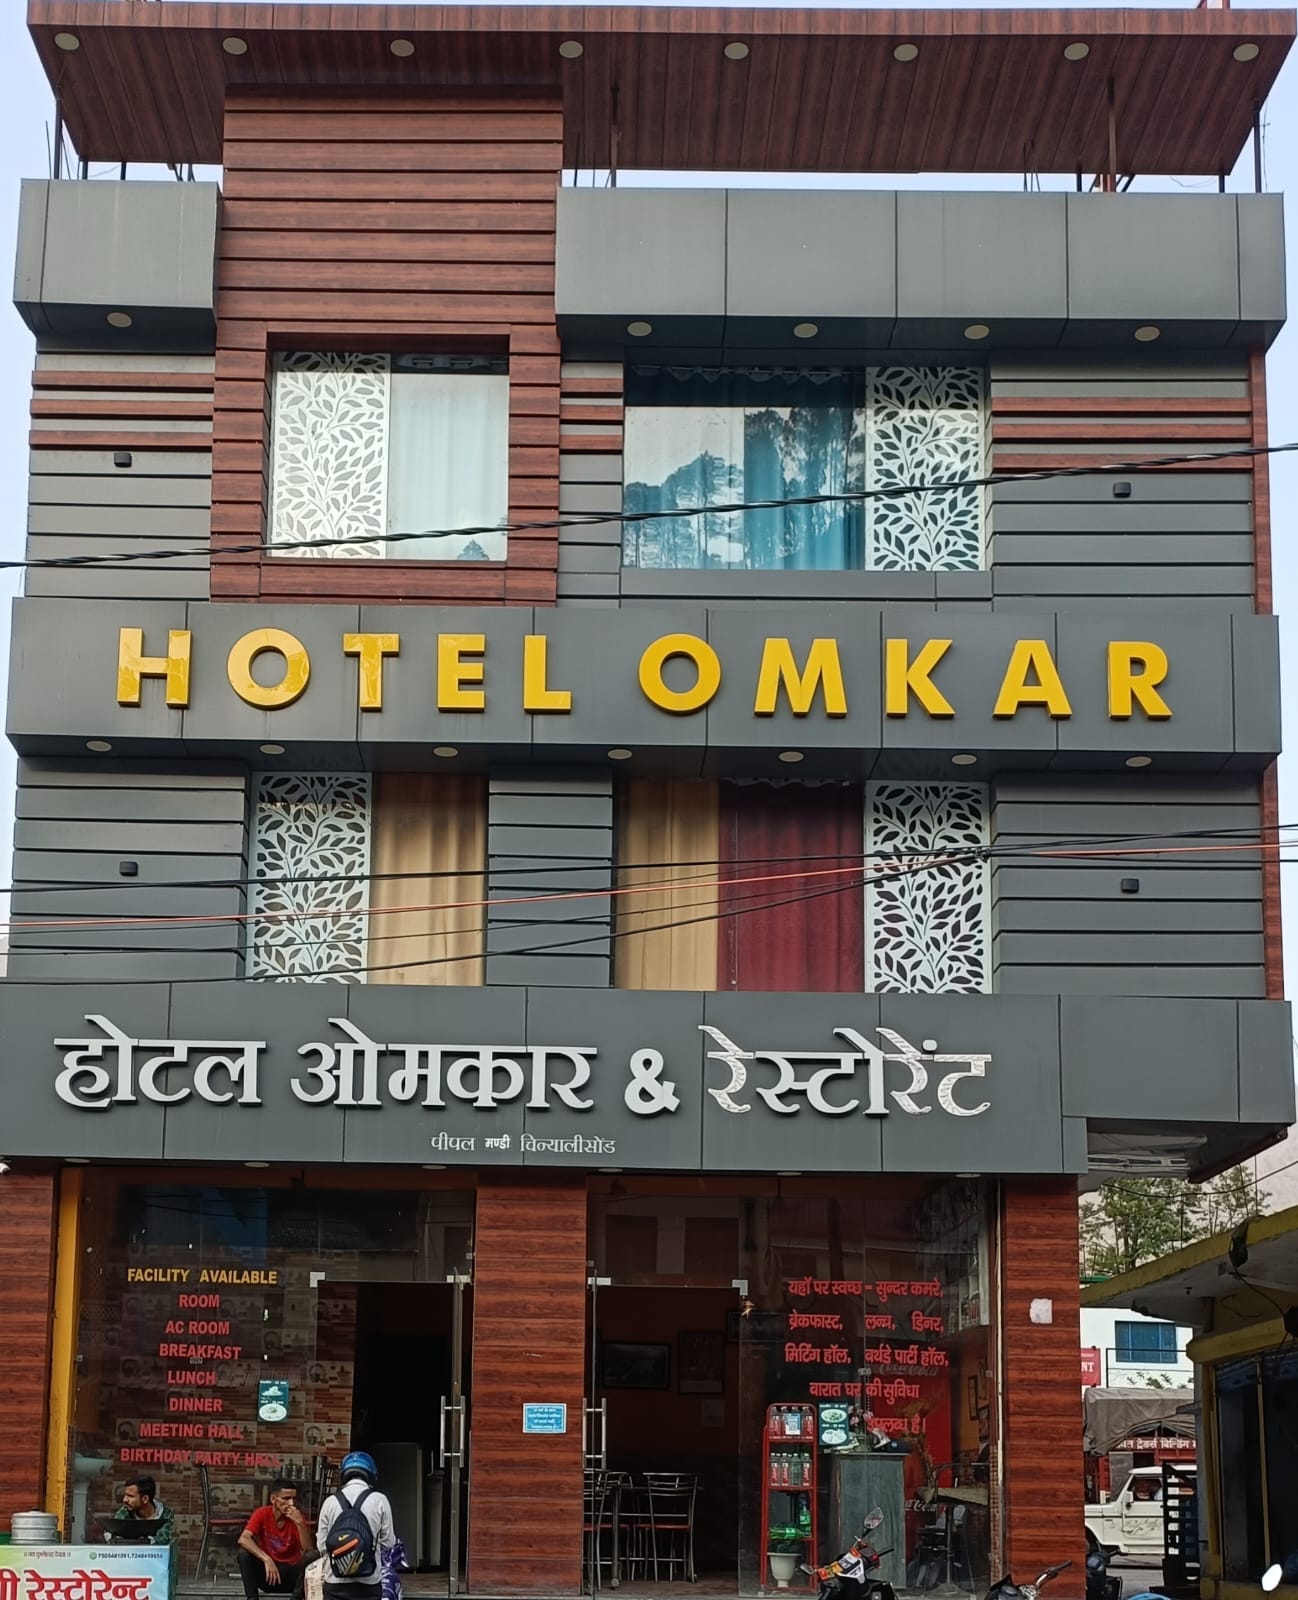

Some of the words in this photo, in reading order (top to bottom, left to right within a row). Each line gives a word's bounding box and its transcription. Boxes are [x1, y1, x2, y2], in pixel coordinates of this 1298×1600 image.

[116, 627, 572, 714] HOTEL
[638, 632, 1174, 721] OMKAR
[53, 1014, 267, 1110] होटल
[290, 1017, 598, 1111] ओमकार
[623, 1047, 681, 1115] &
[697, 1025, 992, 1117] रेस्टोरेंट
[430, 1131, 475, 1151] पीपल
[484, 1134, 511, 1149] मण्डी
[127, 1268, 190, 1282] FACILITY
[200, 1269, 278, 1284] AVAILABLE
[179, 1294, 220, 1308] ROOM
[813, 1280, 829, 1295] पर
[831, 1280, 863, 1295] स्वच्छ
[875, 1280, 909, 1303] सुन्दर
[165, 1320, 185, 1334] AC
[188, 1320, 230, 1335] ROOM
[159, 1343, 242, 1360] BREAKFAST
[894, 1344, 919, 1366] पार्टी
[168, 1370, 217, 1386] LUNCH
[845, 1381, 861, 1397] घर
[865, 1377, 882, 1398] की
[883, 1379, 920, 1405] सुविधा
[169, 1397, 223, 1412] DINNER
[140, 1423, 203, 1437] MEETING
[207, 1424, 244, 1440] HALL
[120, 1447, 191, 1463] BIRTHDAY
[195, 1451, 241, 1466] PARTY
[245, 1452, 281, 1467] HALL
[23, 1569, 153, 1600] रेस्टोरेन्ट
